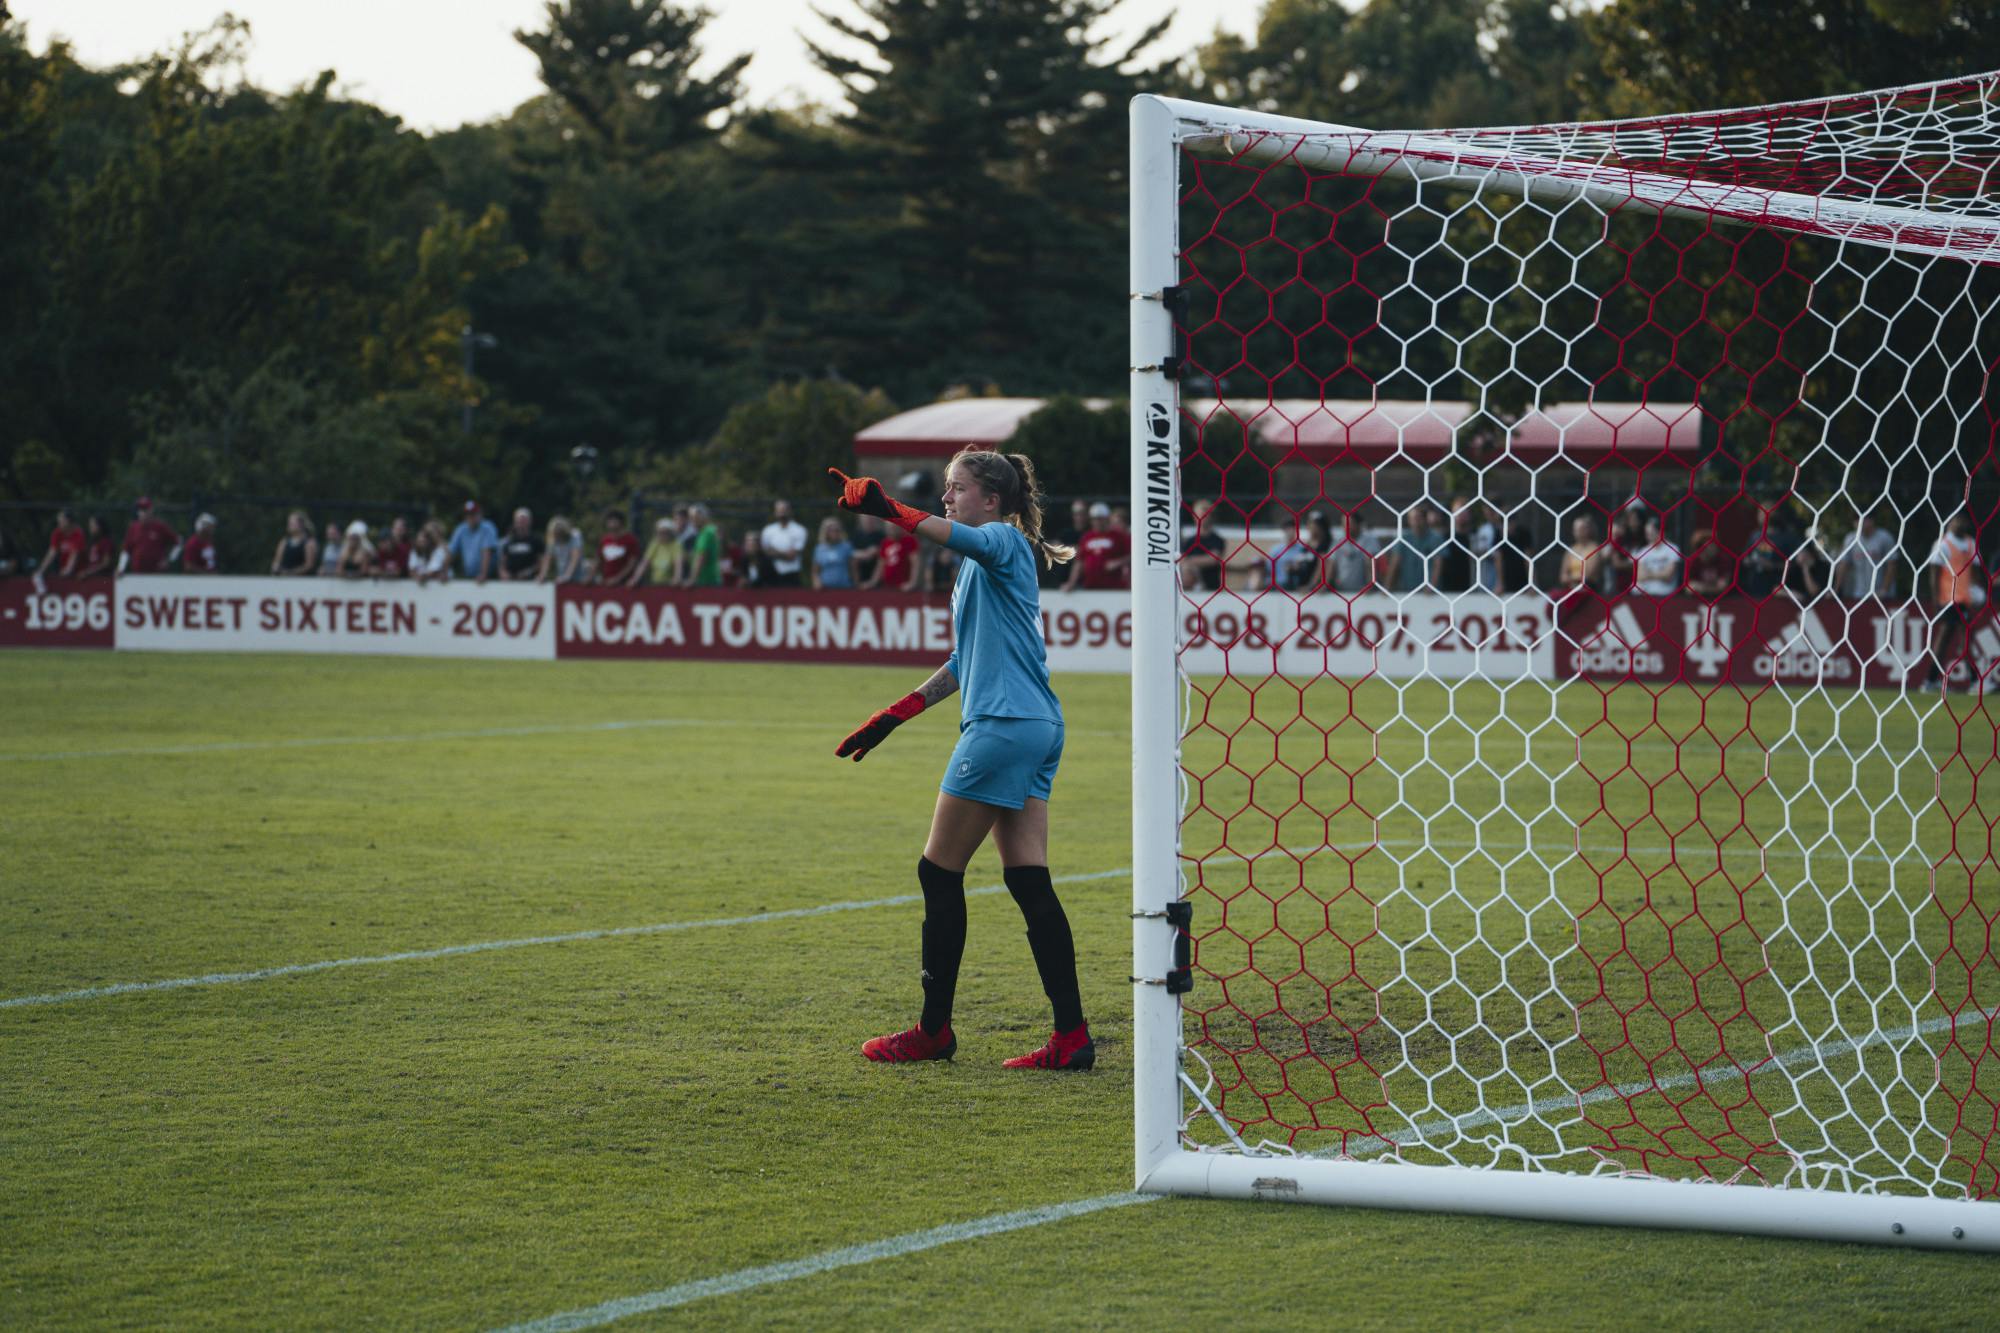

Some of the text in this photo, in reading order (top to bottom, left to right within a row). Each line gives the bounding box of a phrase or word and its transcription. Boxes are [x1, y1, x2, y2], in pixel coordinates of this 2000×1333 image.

[25, 593, 111, 631] 1996
[124, 597, 247, 630] SWEET
[260, 599, 416, 634] SIXTEEN
[452, 603, 545, 637] 2007
[563, 601, 952, 651] NCAA TOURNAME
[1042, 611, 1542, 657] 1996 998, 2007, 2013
[1570, 649, 1664, 674] adidas
[1754, 650, 1852, 679] adidas
